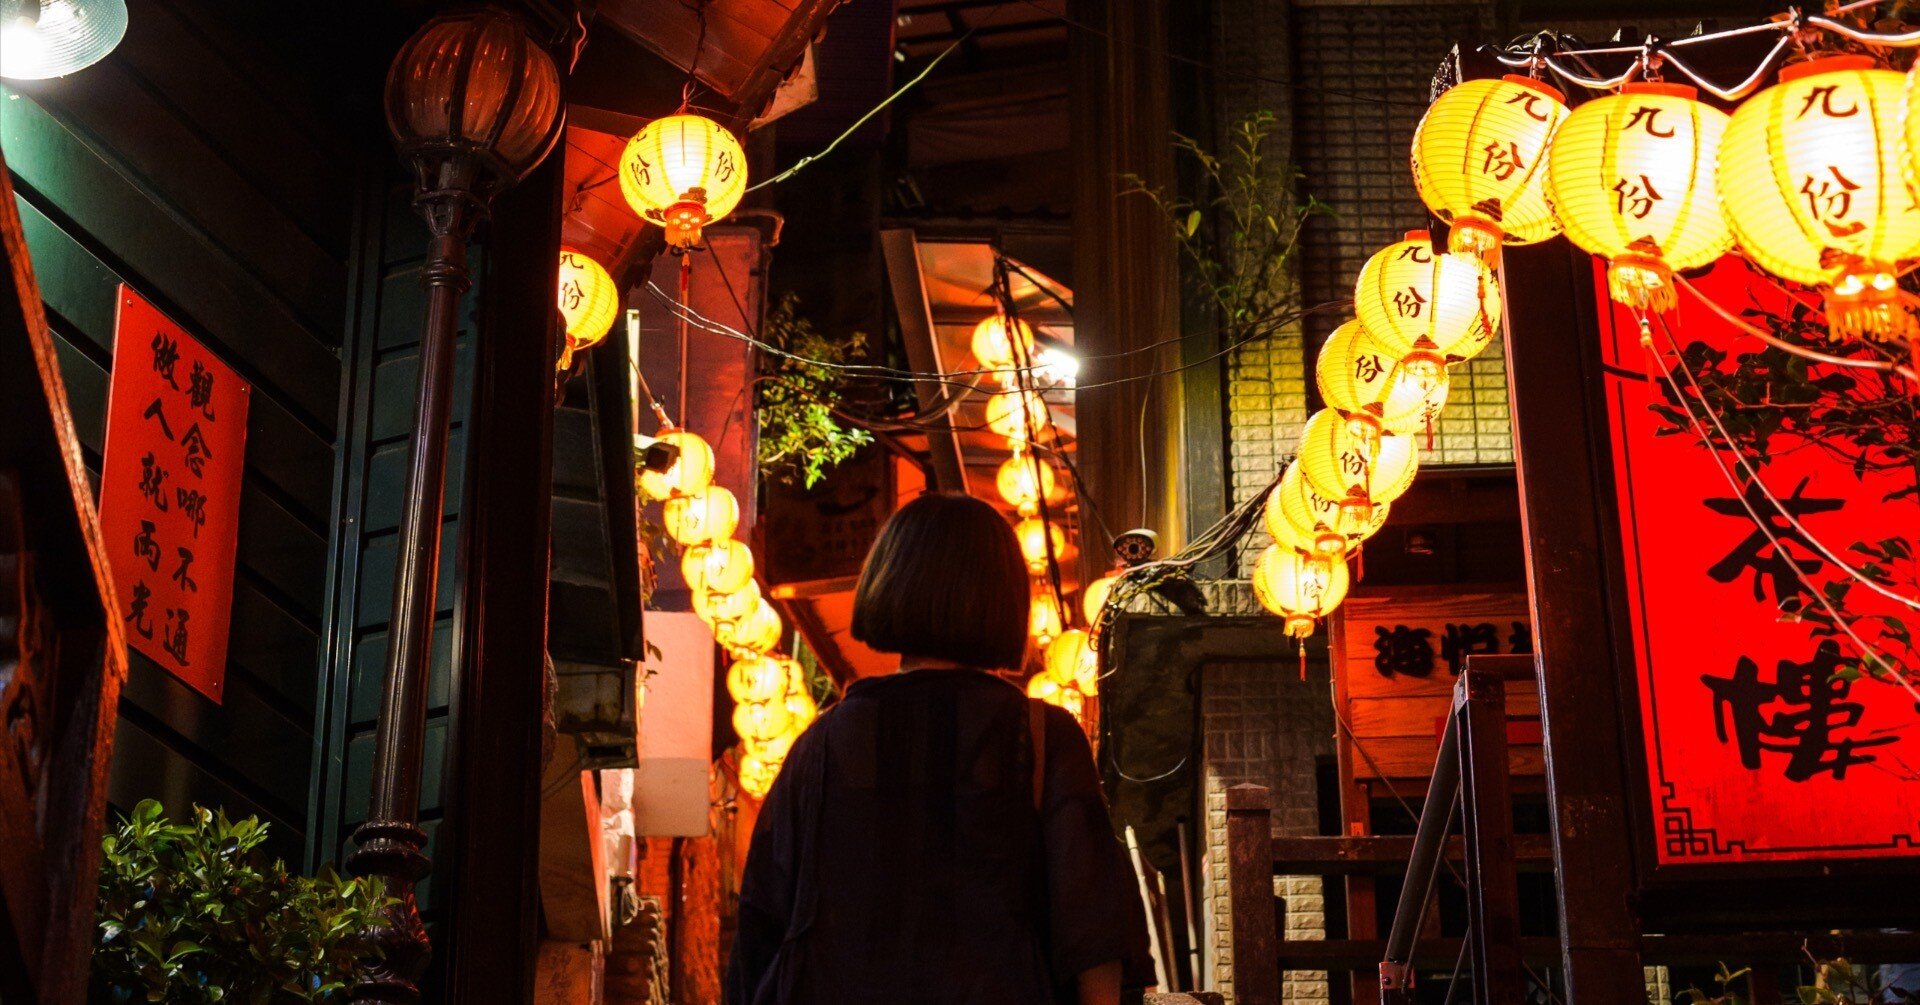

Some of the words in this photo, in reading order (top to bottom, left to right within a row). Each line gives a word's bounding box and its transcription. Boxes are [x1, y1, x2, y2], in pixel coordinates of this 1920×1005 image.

[1484, 90, 1548, 181] 九份
[1612, 106, 1675, 219] 九份
[1797, 85, 1862, 220] 九份
[1393, 245, 1431, 318] 九份
[163, 359, 215, 667] 觀念哪不通
[1701, 475, 1902, 783] 茶樓
